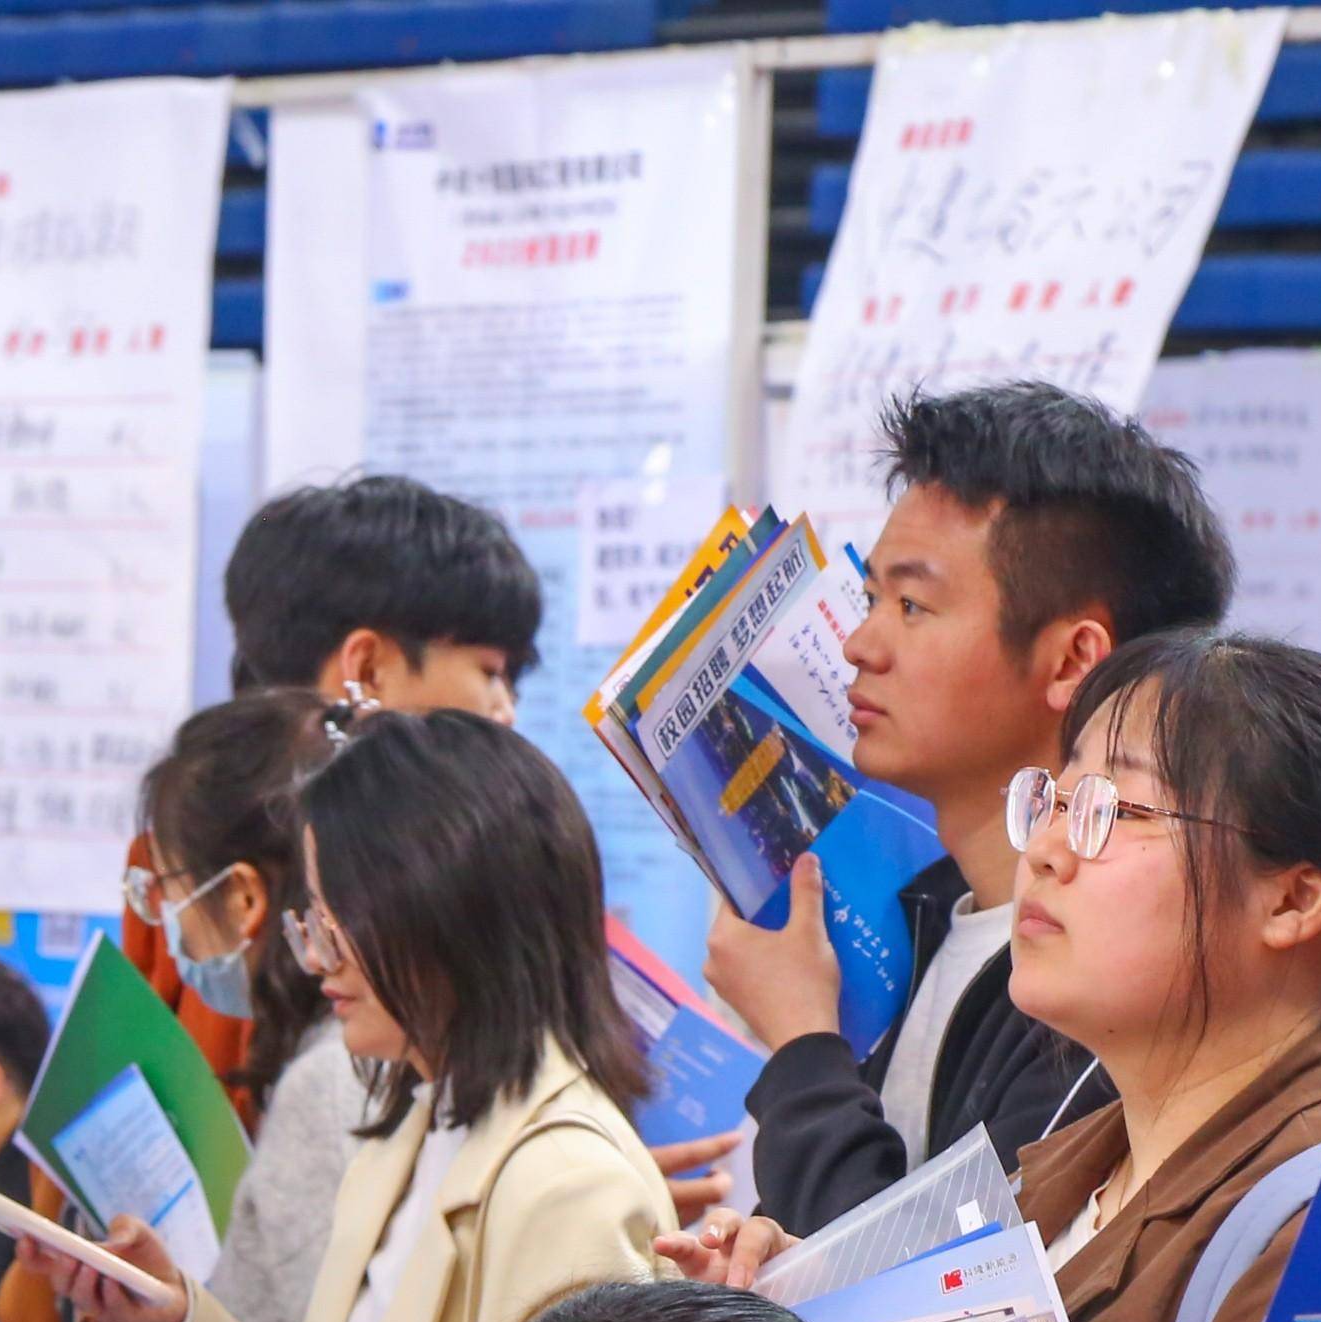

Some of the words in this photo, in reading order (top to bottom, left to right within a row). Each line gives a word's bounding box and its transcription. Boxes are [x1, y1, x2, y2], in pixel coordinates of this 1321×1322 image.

[657, 646, 731, 752] 校园招聘
[730, 547, 803, 652] 梦想起航
